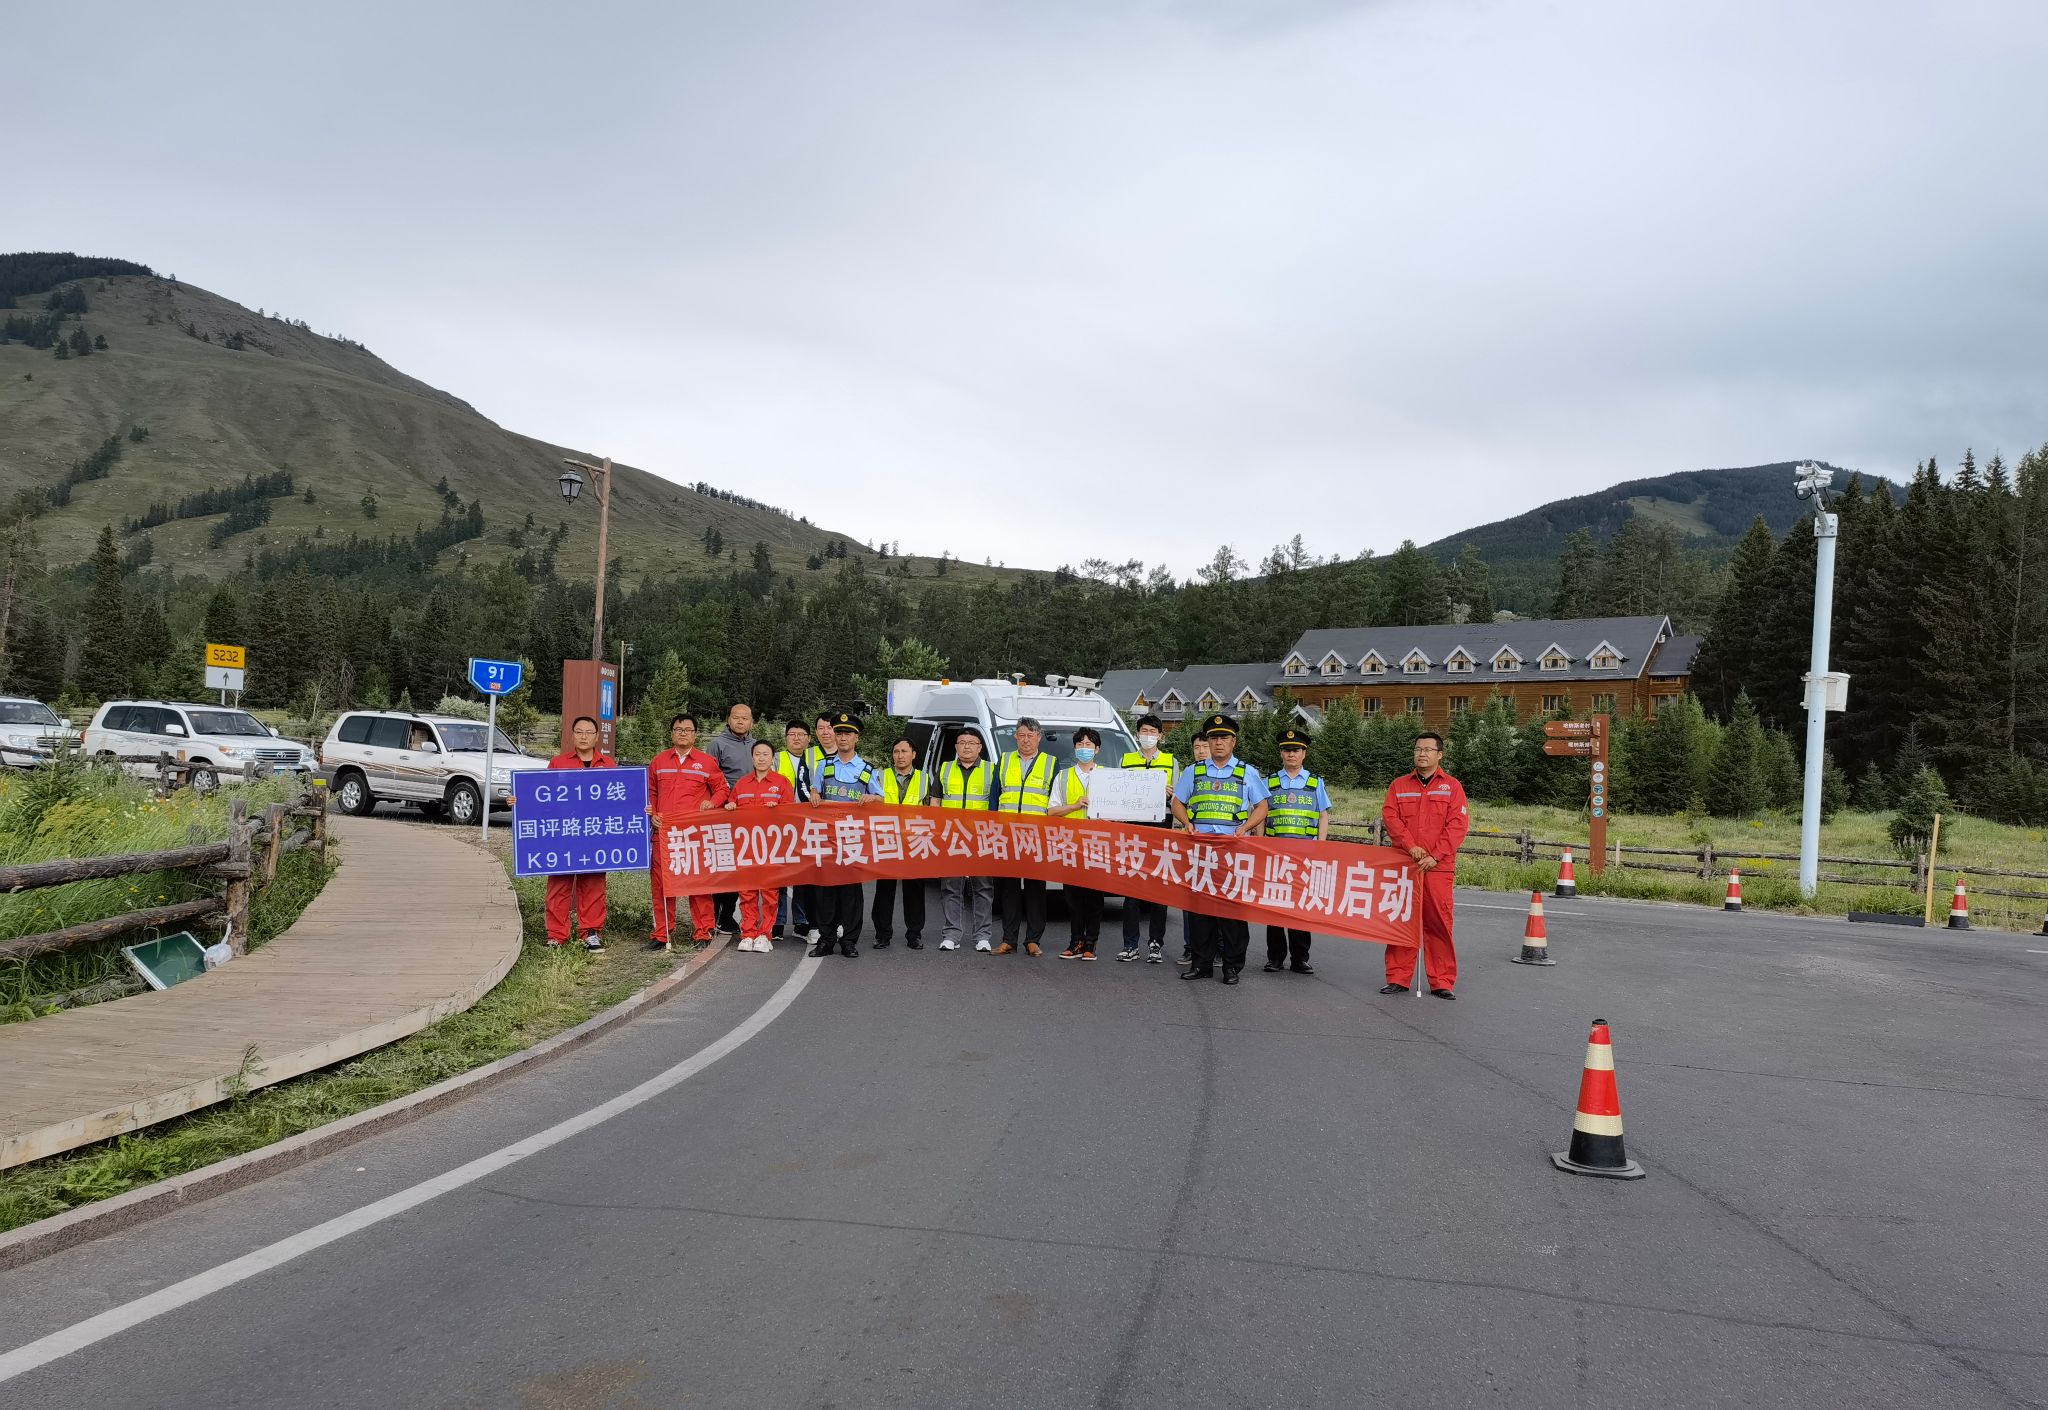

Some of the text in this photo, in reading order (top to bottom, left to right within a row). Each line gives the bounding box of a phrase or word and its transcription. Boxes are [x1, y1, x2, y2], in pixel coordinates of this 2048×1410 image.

[213, 648, 239, 663] S232
[488, 666, 505, 681] 91
[535, 781, 626, 803] G219线
[1196, 781, 1239, 792] 交通 执法
[1272, 794, 1313, 805] 交通 执法
[1220, 803, 1236, 812] ZHIFA
[518, 814, 645, 839] 国评路段起点
[528, 848, 638, 869] K91+000
[667, 815, 1414, 922] 新疆2022年度国家公路网路面技术状况监测启动
